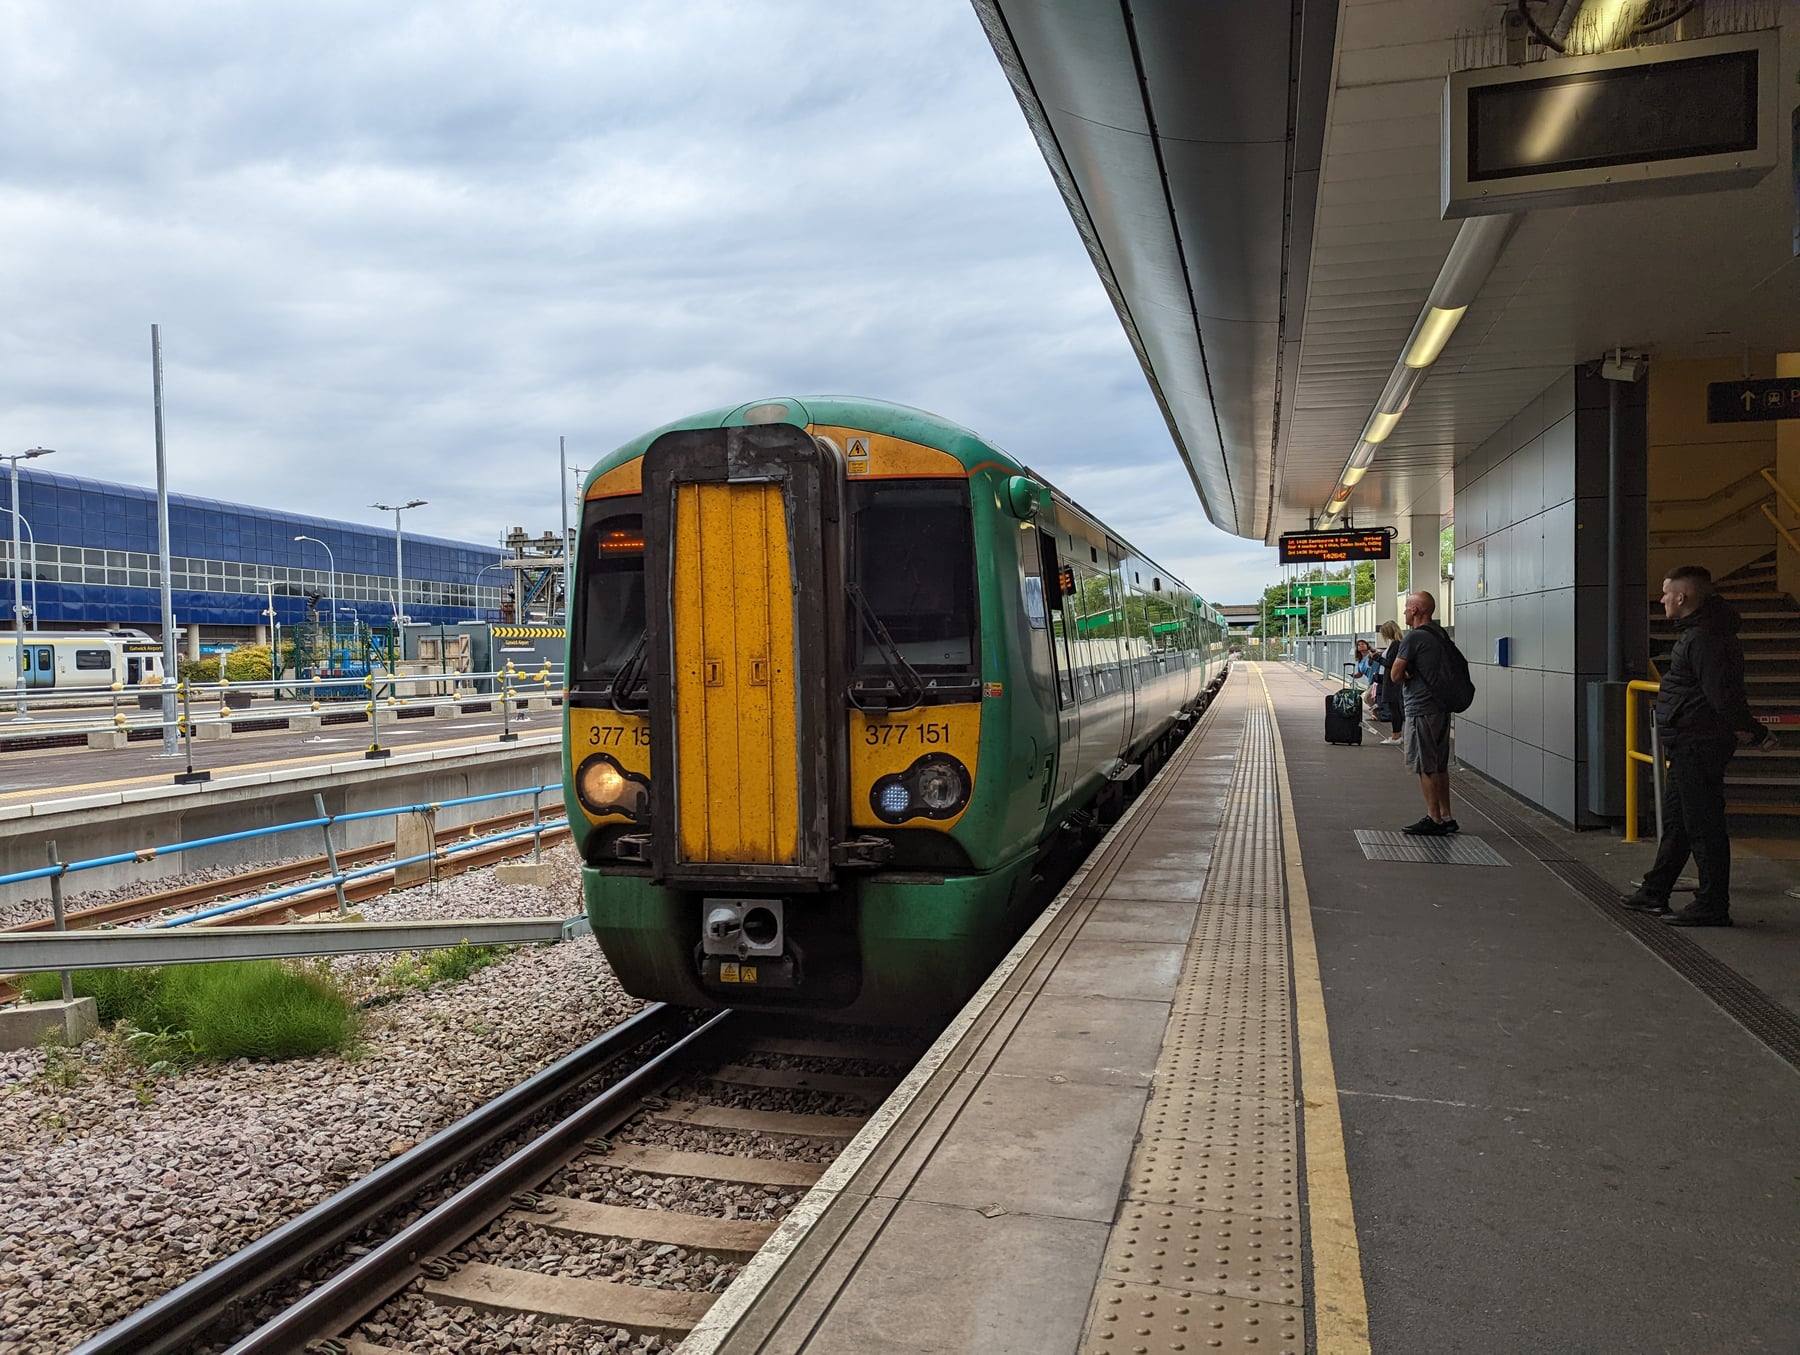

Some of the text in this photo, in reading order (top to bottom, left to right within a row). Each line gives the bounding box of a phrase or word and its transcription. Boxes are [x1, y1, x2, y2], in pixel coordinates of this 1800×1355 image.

[589, 725, 625, 746] 377
[865, 723, 949, 745] 377 151
